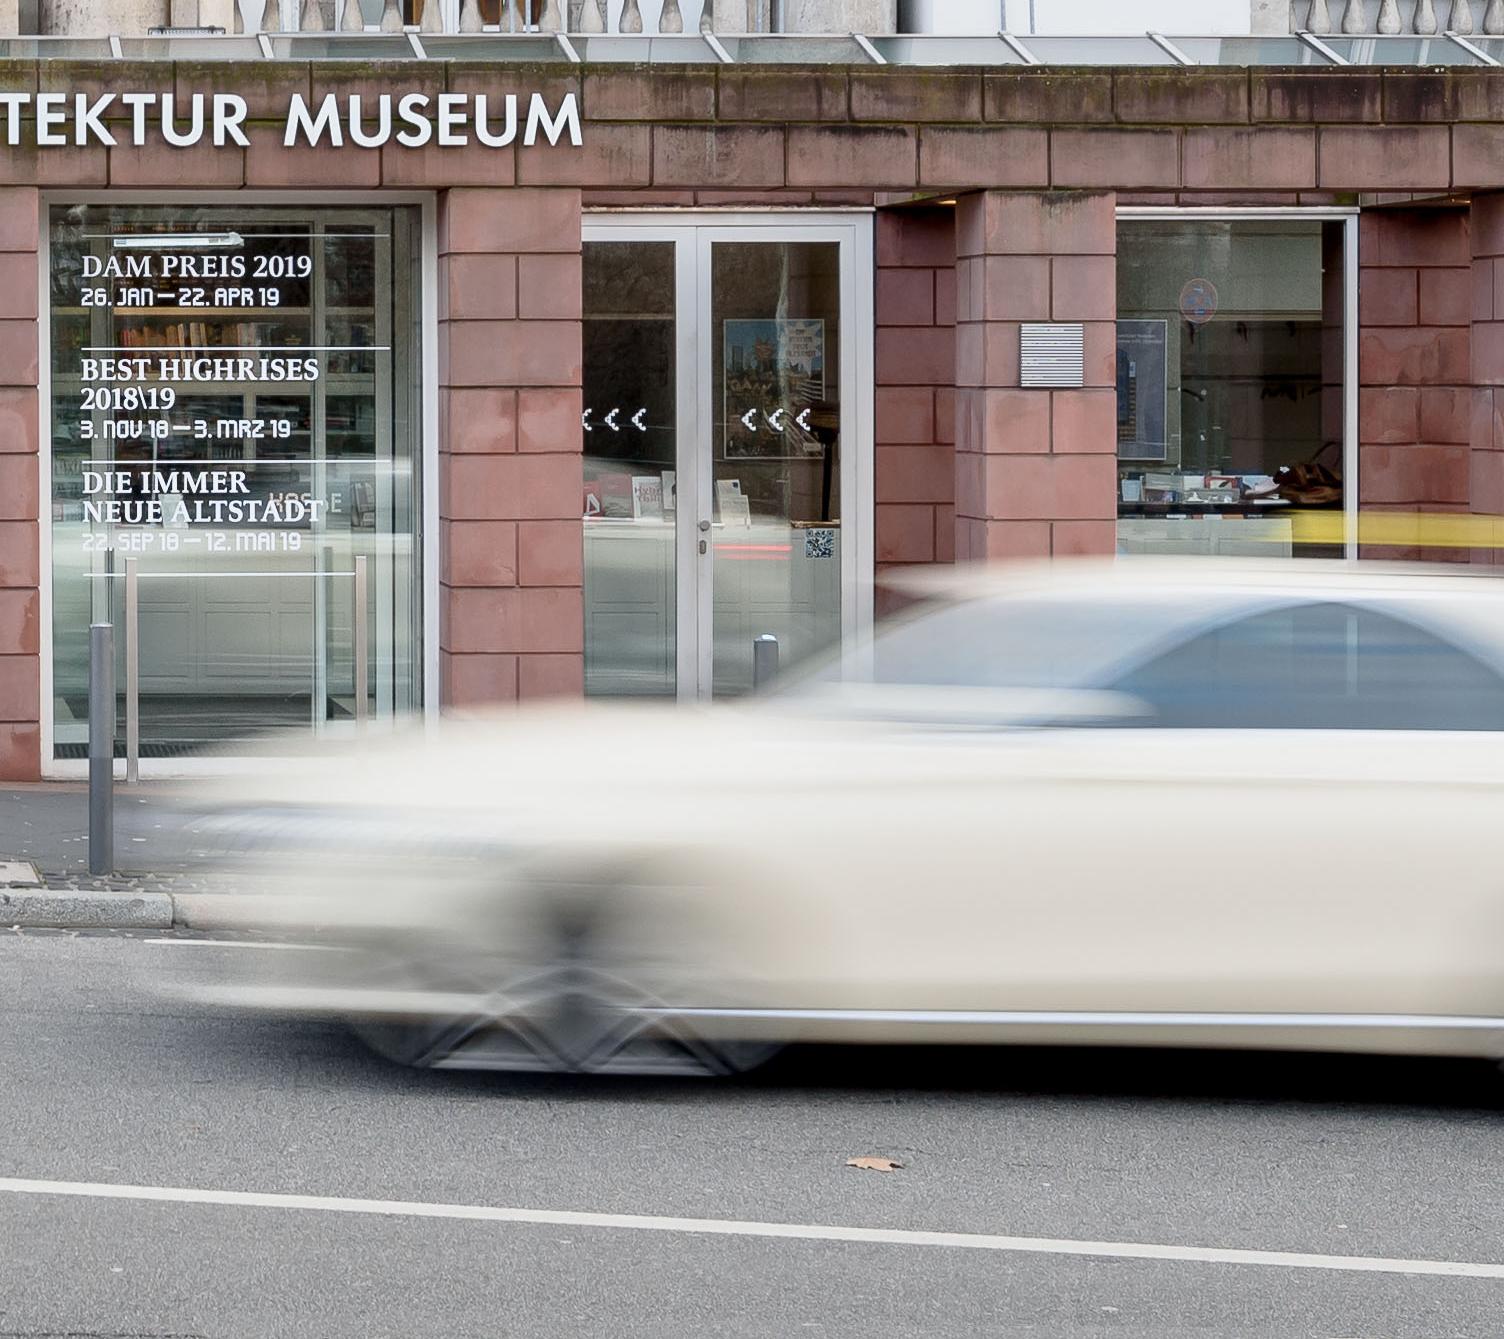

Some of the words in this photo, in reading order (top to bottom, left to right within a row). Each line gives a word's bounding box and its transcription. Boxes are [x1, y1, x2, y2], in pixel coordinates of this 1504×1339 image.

[283, 90, 583, 147] MUSEUM
[81, 255, 152, 278] DAM
[161, 255, 246, 278] PREIS
[253, 255, 312, 278] 2019
[81, 288, 112, 307] 26.
[117, 288, 153, 307] JAN
[178, 288, 210, 307] 22.
[215, 288, 254, 307] APR
[258, 288, 280, 307] 19
[81, 359, 151, 381] BEST
[158, 359, 319, 381] HIGHRISES
[79, 385, 176, 411] 2018\19
[80, 419, 98, 439] 3.
[103, 419, 142, 439] NOV
[148, 419, 169, 439] 18
[194, 419, 212, 439] 3.
[217, 419, 264, 439] MRZ
[270, 419, 291, 439] 19
[82, 471, 132, 494] DIE
[141, 471, 250, 494] IMMER
[82, 500, 163, 523] NEUE
[172, 500, 323, 523] ALTSTADT
[81, 532, 113, 552] 22.
[118, 532, 155, 552] SEP
[159, 532, 179, 552] 18
[205, 532, 231, 552] 12.
[236, 532, 275, 552] MAI
[280, 532, 301, 552] 19
